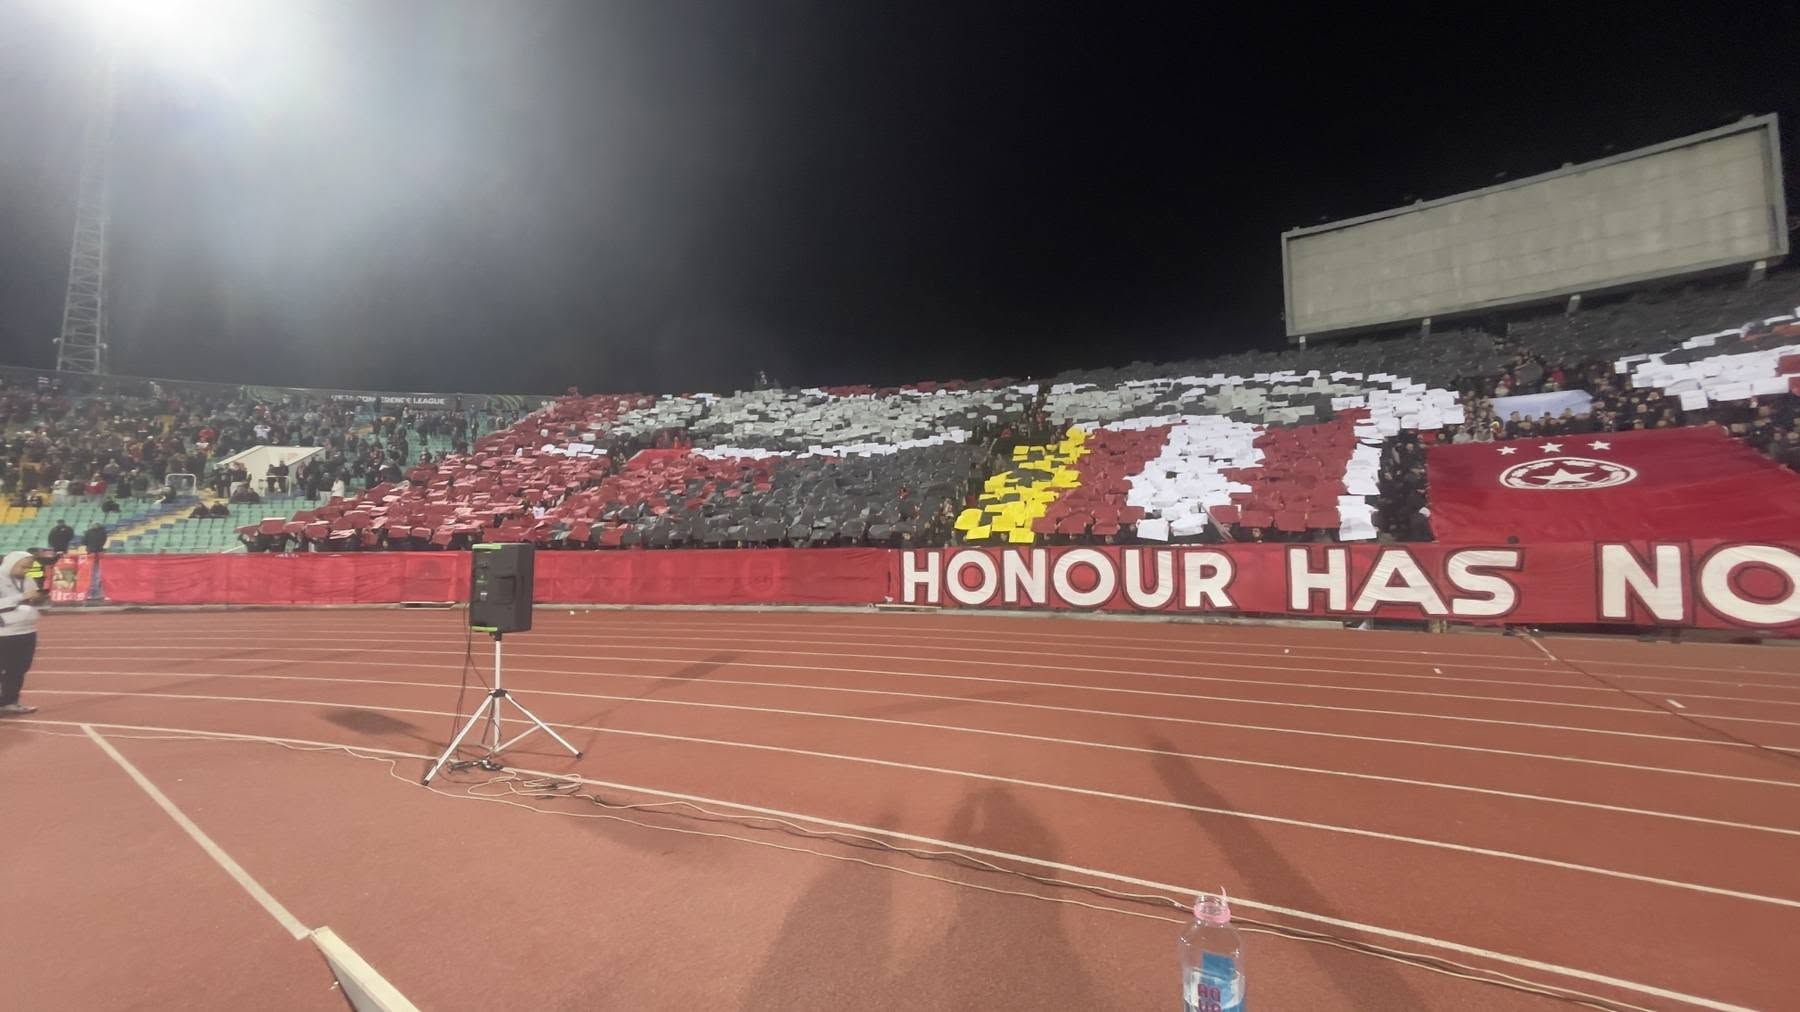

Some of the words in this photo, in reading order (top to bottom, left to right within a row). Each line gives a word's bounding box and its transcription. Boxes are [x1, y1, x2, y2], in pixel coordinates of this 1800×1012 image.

[413, 397, 445, 405] LEAGUE
[902, 547, 1234, 609] HONOUR
[1289, 548, 1519, 616] HAS
[1602, 544, 1800, 623] NO
